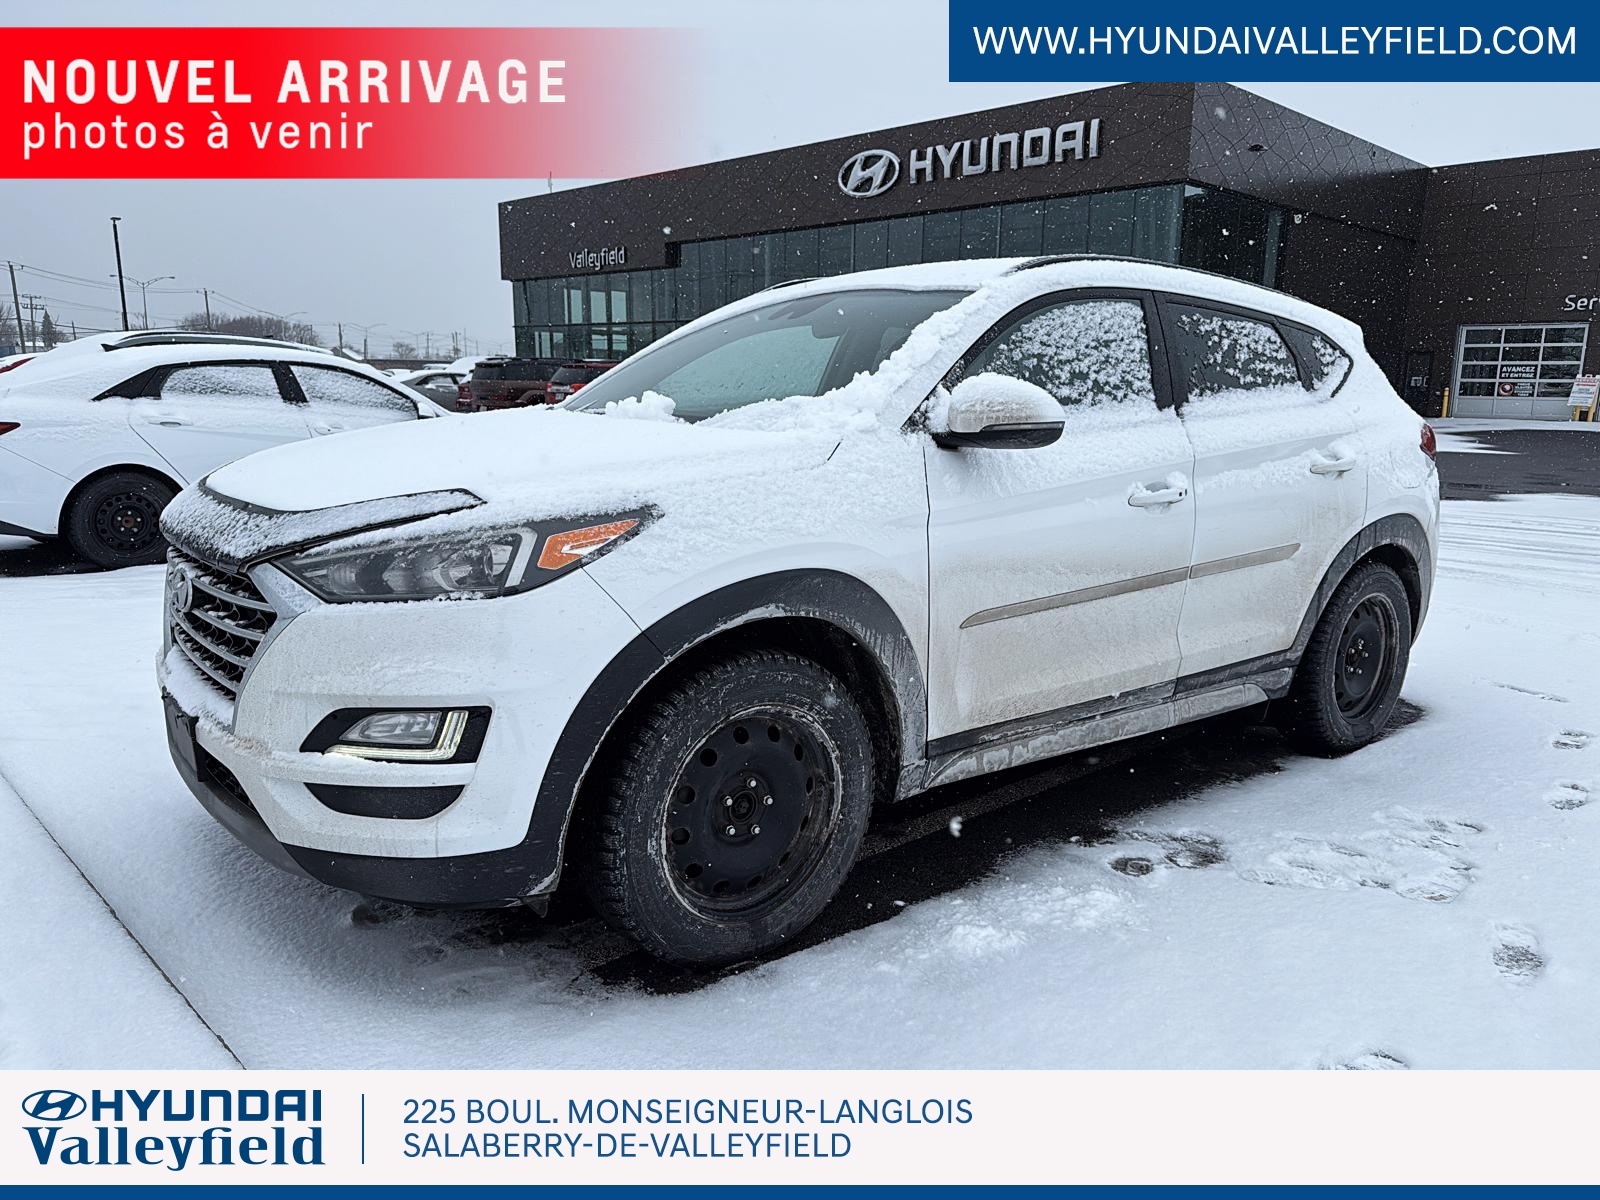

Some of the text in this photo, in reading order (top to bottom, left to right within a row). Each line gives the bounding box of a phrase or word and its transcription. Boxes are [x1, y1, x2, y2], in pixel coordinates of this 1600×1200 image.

[909, 118, 1100, 184] HYUNDAI
[568, 246, 625, 271] Valleyfield
[1564, 294, 1600, 311] Ser
